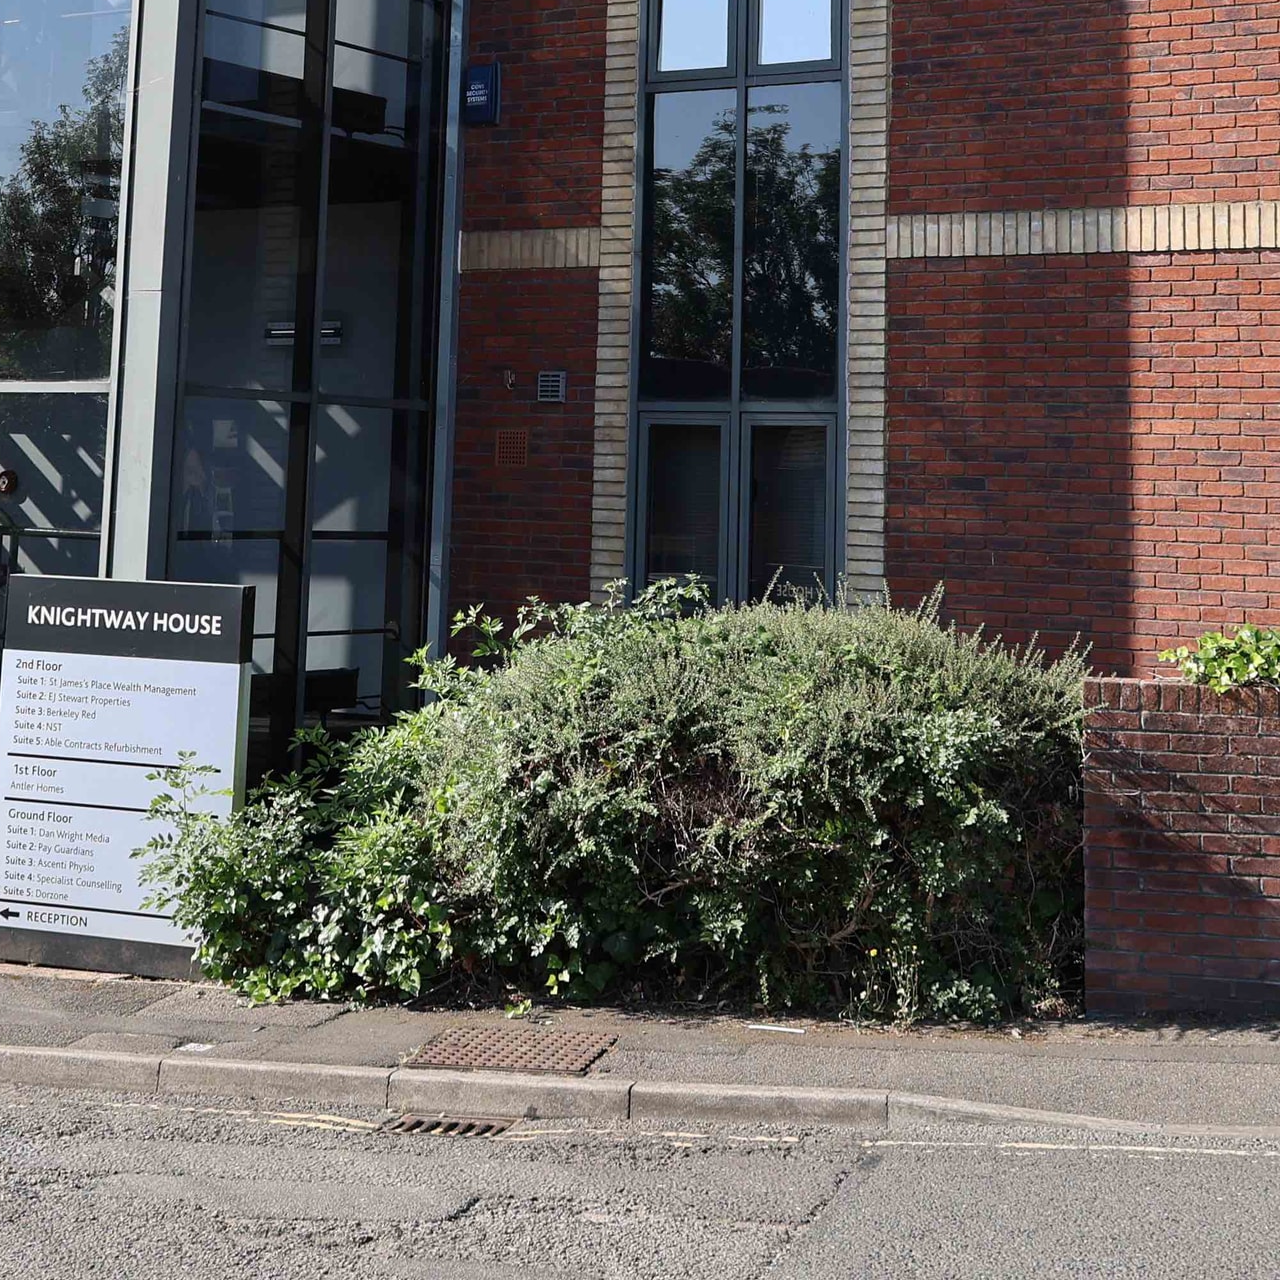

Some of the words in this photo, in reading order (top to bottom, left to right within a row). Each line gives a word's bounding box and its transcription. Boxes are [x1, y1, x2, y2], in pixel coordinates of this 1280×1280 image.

[27, 605, 149, 631] KNIGHTWAY
[153, 613, 222, 635] HOUSE
[16, 659, 34, 670] 2nd
[36, 660, 62, 671] Floor
[17, 675, 38, 685] Suite
[40, 677, 47, 685] 1:
[49, 678, 58, 686] St
[91, 681, 112, 690] Place
[113, 681, 142, 692] Wealth
[144, 684, 197, 696] Management
[16, 690, 37, 700] Suite
[38, 692, 47, 701] 2:
[48, 693, 57, 703] EJ
[58, 694, 88, 704] Stewart
[91, 696, 131, 707] Properties
[15, 706, 36, 716] Suite
[37, 707, 46, 716] 3:
[46, 708, 80, 721] Berkeley
[81, 710, 96, 719] Red
[14, 720, 35, 730] Suite
[36, 722, 45, 731] 4:
[45, 722, 62, 732] NST
[13, 735, 34, 745] Suite
[35, 737, 43, 746] 5:
[44, 737, 62, 747] Able
[64, 739, 102, 751] Contracts
[104, 742, 162, 755] Refurbishment
[14, 764, 29, 775] 1st
[32, 765, 57, 777] Floor
[10, 781, 34, 791] Antler
[36, 783, 64, 794] Homes
[8, 808, 45, 821] Ground
[47, 811, 73, 823] Floor
[7, 825, 28, 835] Suite
[30, 827, 37, 836] 1:
[39, 828, 55, 838] Dan
[56, 830, 83, 842] Wright
[85, 832, 110, 843] Media
[6, 840, 27, 851] Suite
[29, 842, 36, 851] 2:
[38, 843, 52, 854] Pay
[54, 844, 94, 857] Guardians
[5, 856, 26, 866] Suite
[28, 858, 36, 867] 3:
[38, 859, 67, 869] Ascenti
[69, 861, 95, 873] Physio
[4, 871, 25, 881] Suite
[27, 872, 35, 881] 4:
[36, 874, 73, 886] Specialist
[76, 878, 122, 893] Counselling
[3, 886, 24, 896] Suite
[26, 888, 34, 897] 5:
[35, 889, 69, 901] Dorzone
[27, 911, 88, 927] RECEPTION
